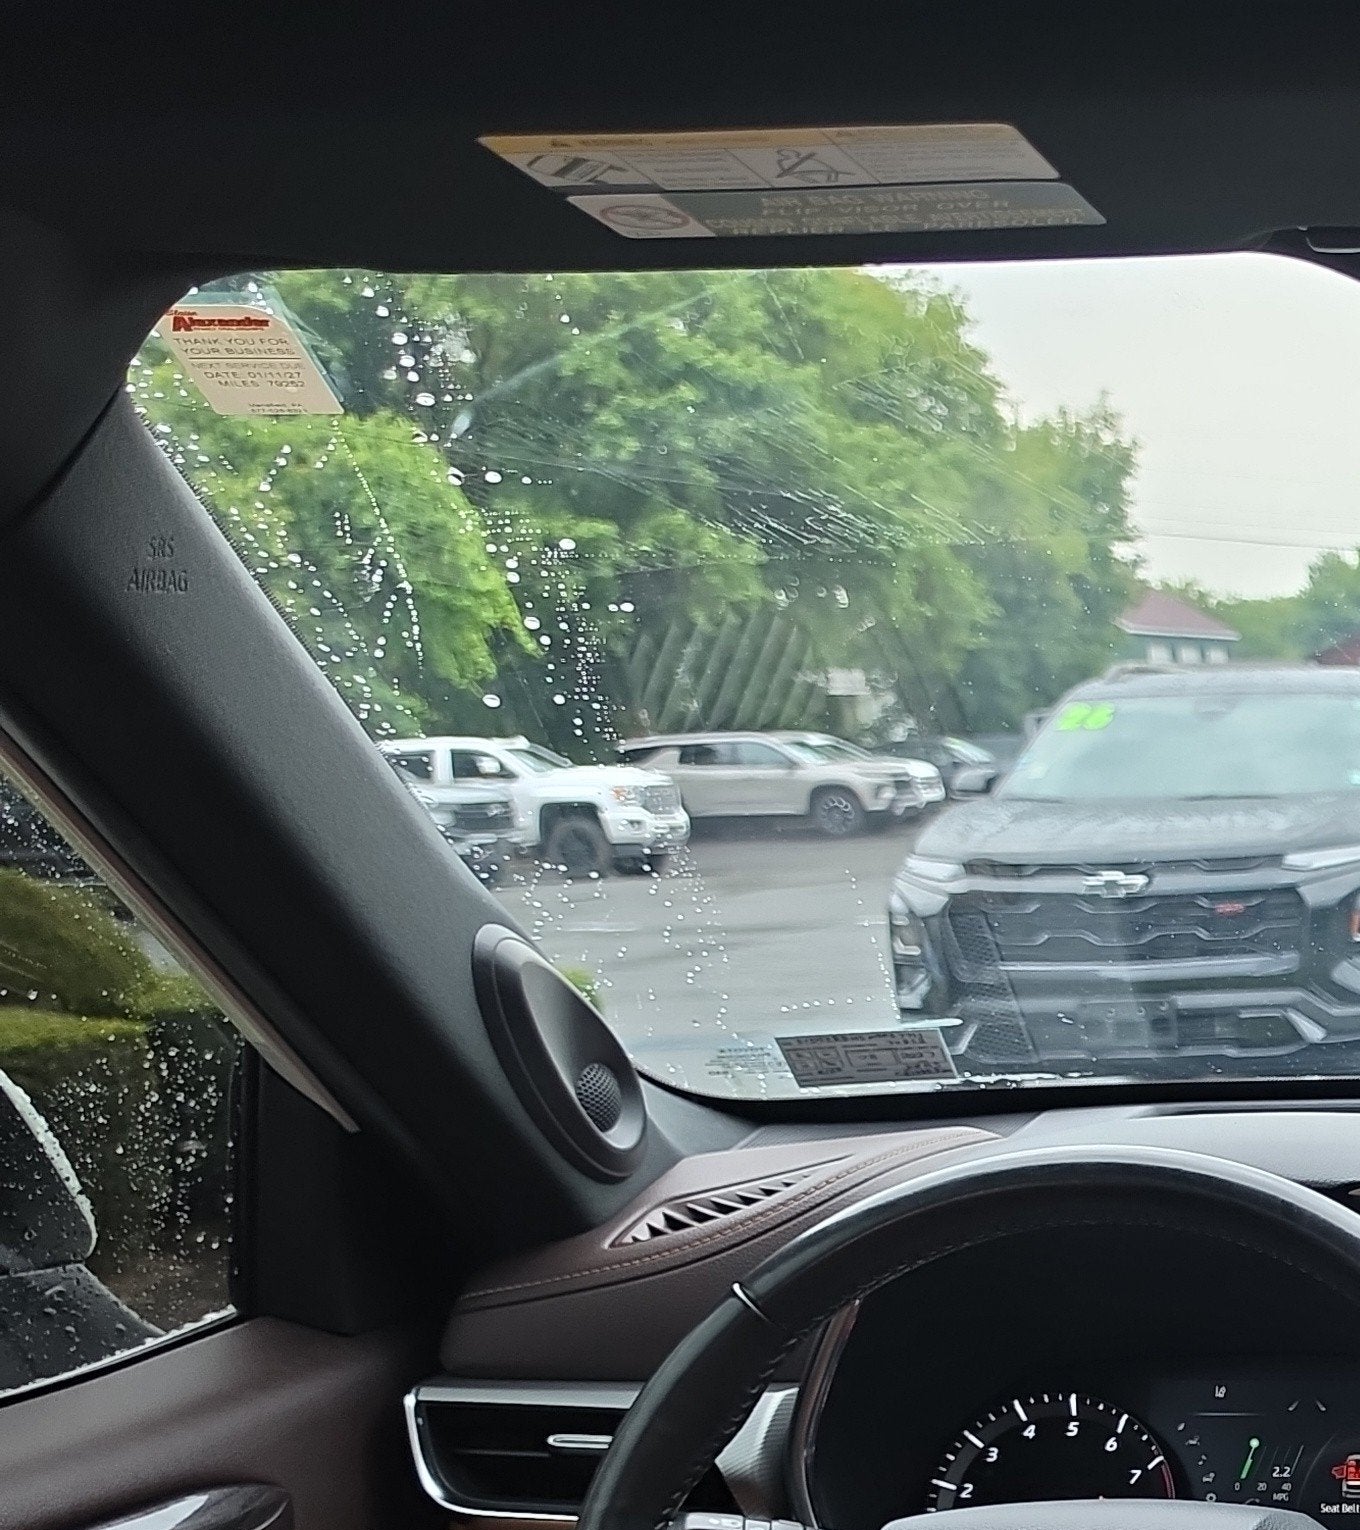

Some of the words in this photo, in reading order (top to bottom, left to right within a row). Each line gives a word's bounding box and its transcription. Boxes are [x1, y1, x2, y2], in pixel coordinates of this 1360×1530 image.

[937, 200, 1008, 210] OVER
[174, 337, 218, 345] THANK
[227, 337, 254, 345] YOU
[260, 337, 289, 345] FOR
[182, 347, 220, 356] YOUR
[225, 347, 295, 356] BUSINESS
[192, 362, 221, 370] NEXT
[232, 362, 280, 370] SERVICE
[219, 380, 260, 388] MILES
[1022, 1424, 1036, 1439] 4
[1065, 1421, 1080, 1437] 5
[1104, 1437, 1118, 1452] 6
[986, 1447, 999, 1462] 3
[1128, 1469, 1142, 1485] 7
[1272, 1466, 1291, 1478] 2.2
[960, 1483, 974, 1498] 2
[1320, 1503, 1339, 1514] Seat
[1341, 1503, 1360, 1514] Belt
